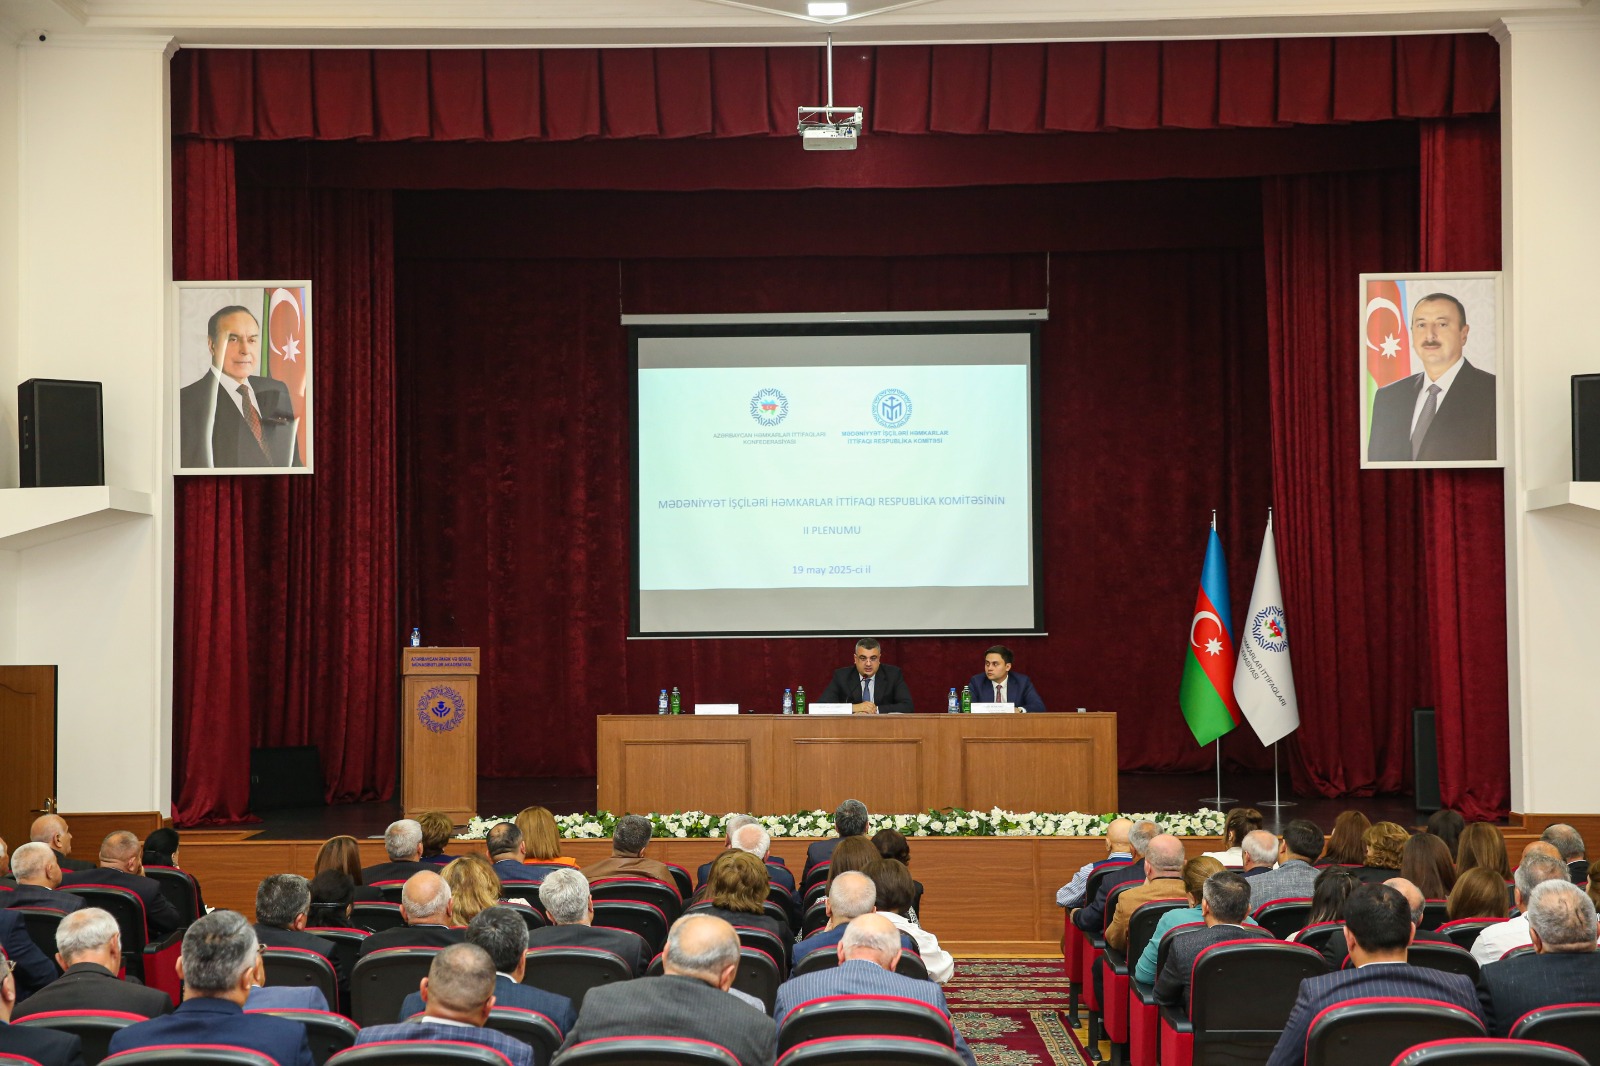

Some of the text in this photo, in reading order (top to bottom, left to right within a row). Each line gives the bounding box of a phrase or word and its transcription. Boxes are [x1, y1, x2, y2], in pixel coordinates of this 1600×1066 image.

[658, 494, 1006, 510] MƏDƏNİYYƏT İŞÇİLƏRİ HƏMKARLAR İTTİFAQI RESPUBLİKA KOMİTƏSİNİN
[803, 526, 862, 535] II PLENUMU
[792, 564, 871, 576] 19 may 2025-ci il
